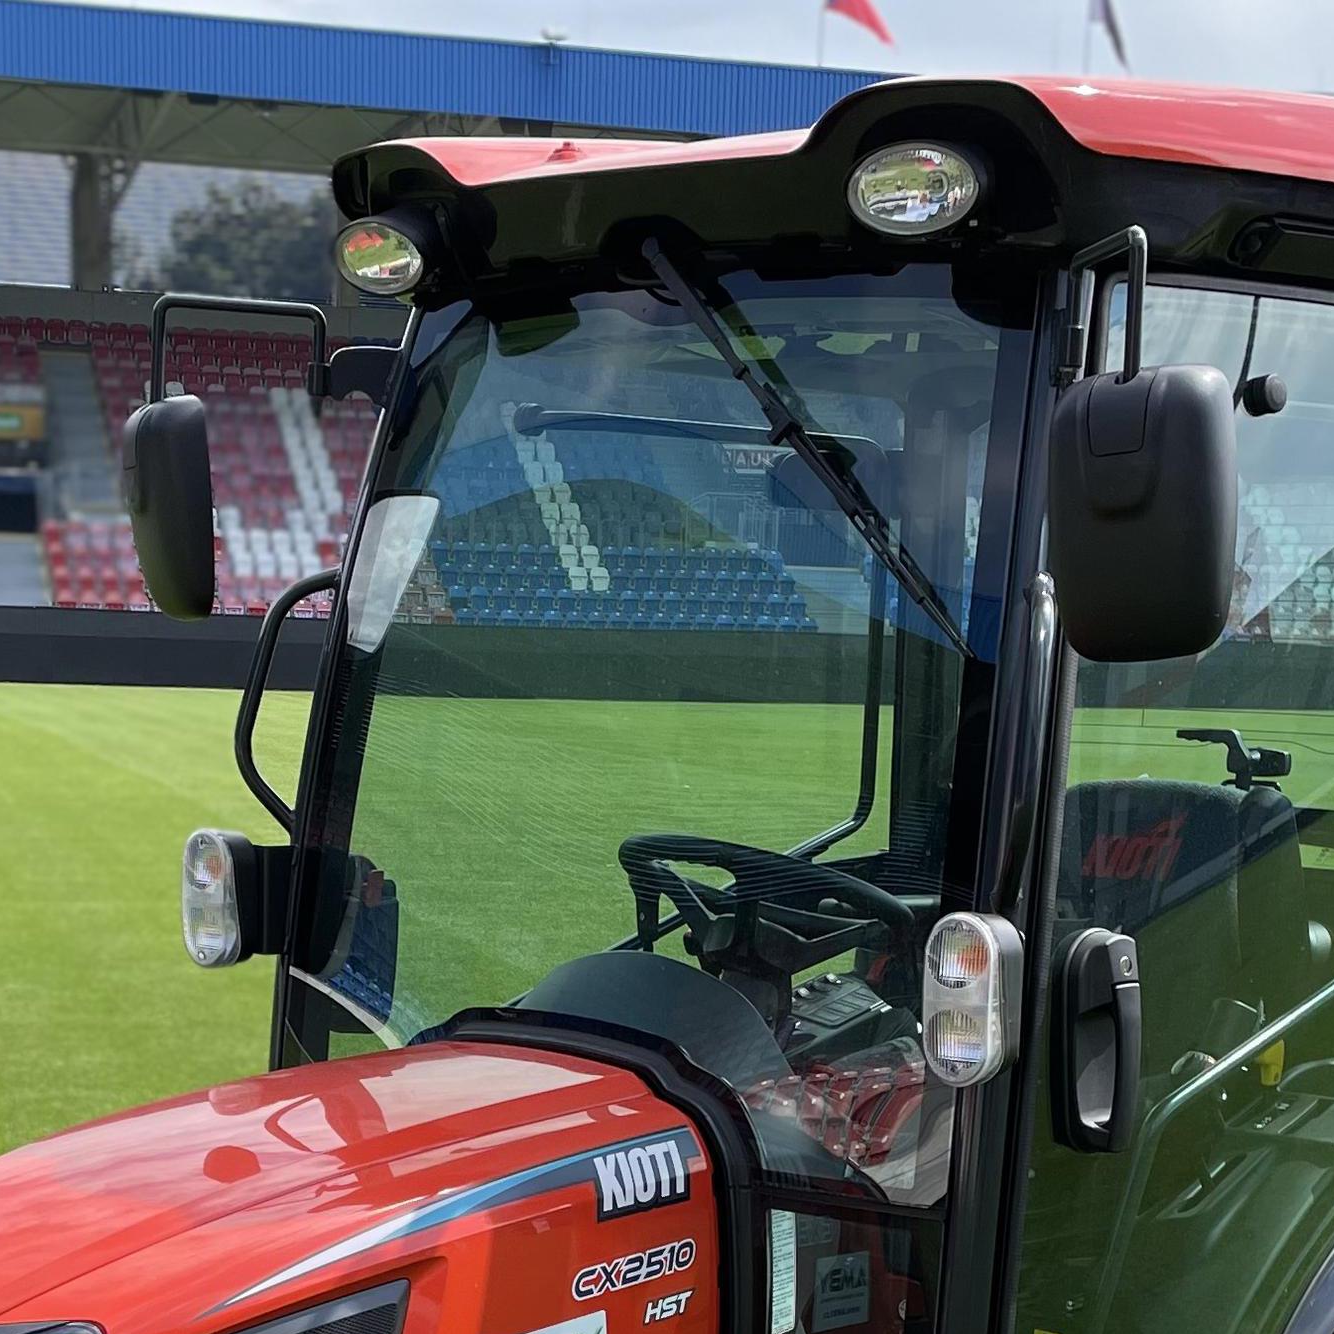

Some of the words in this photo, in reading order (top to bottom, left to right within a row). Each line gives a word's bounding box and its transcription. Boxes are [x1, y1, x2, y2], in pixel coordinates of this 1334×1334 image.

[593, 1140, 685, 1212] KIOTI
[573, 1239, 696, 1301] CX2510
[644, 1291, 694, 1324] HST
